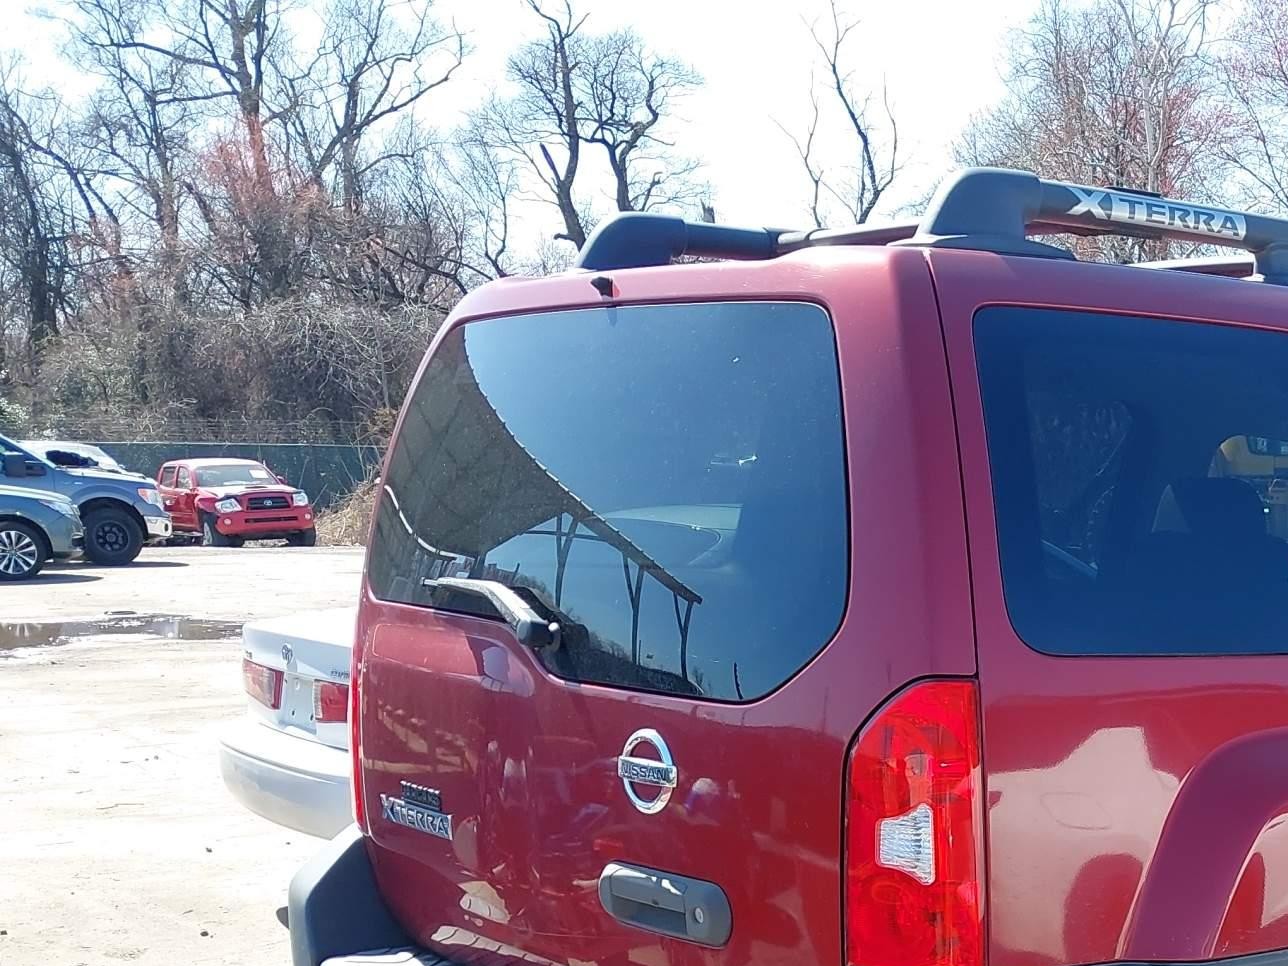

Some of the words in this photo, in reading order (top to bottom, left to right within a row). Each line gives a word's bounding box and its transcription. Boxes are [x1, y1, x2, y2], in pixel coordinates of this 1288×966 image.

[1065, 186, 1246, 240] XTERRA
[620, 759, 670, 784] NISSAN
[380, 793, 453, 840] XTERRA
